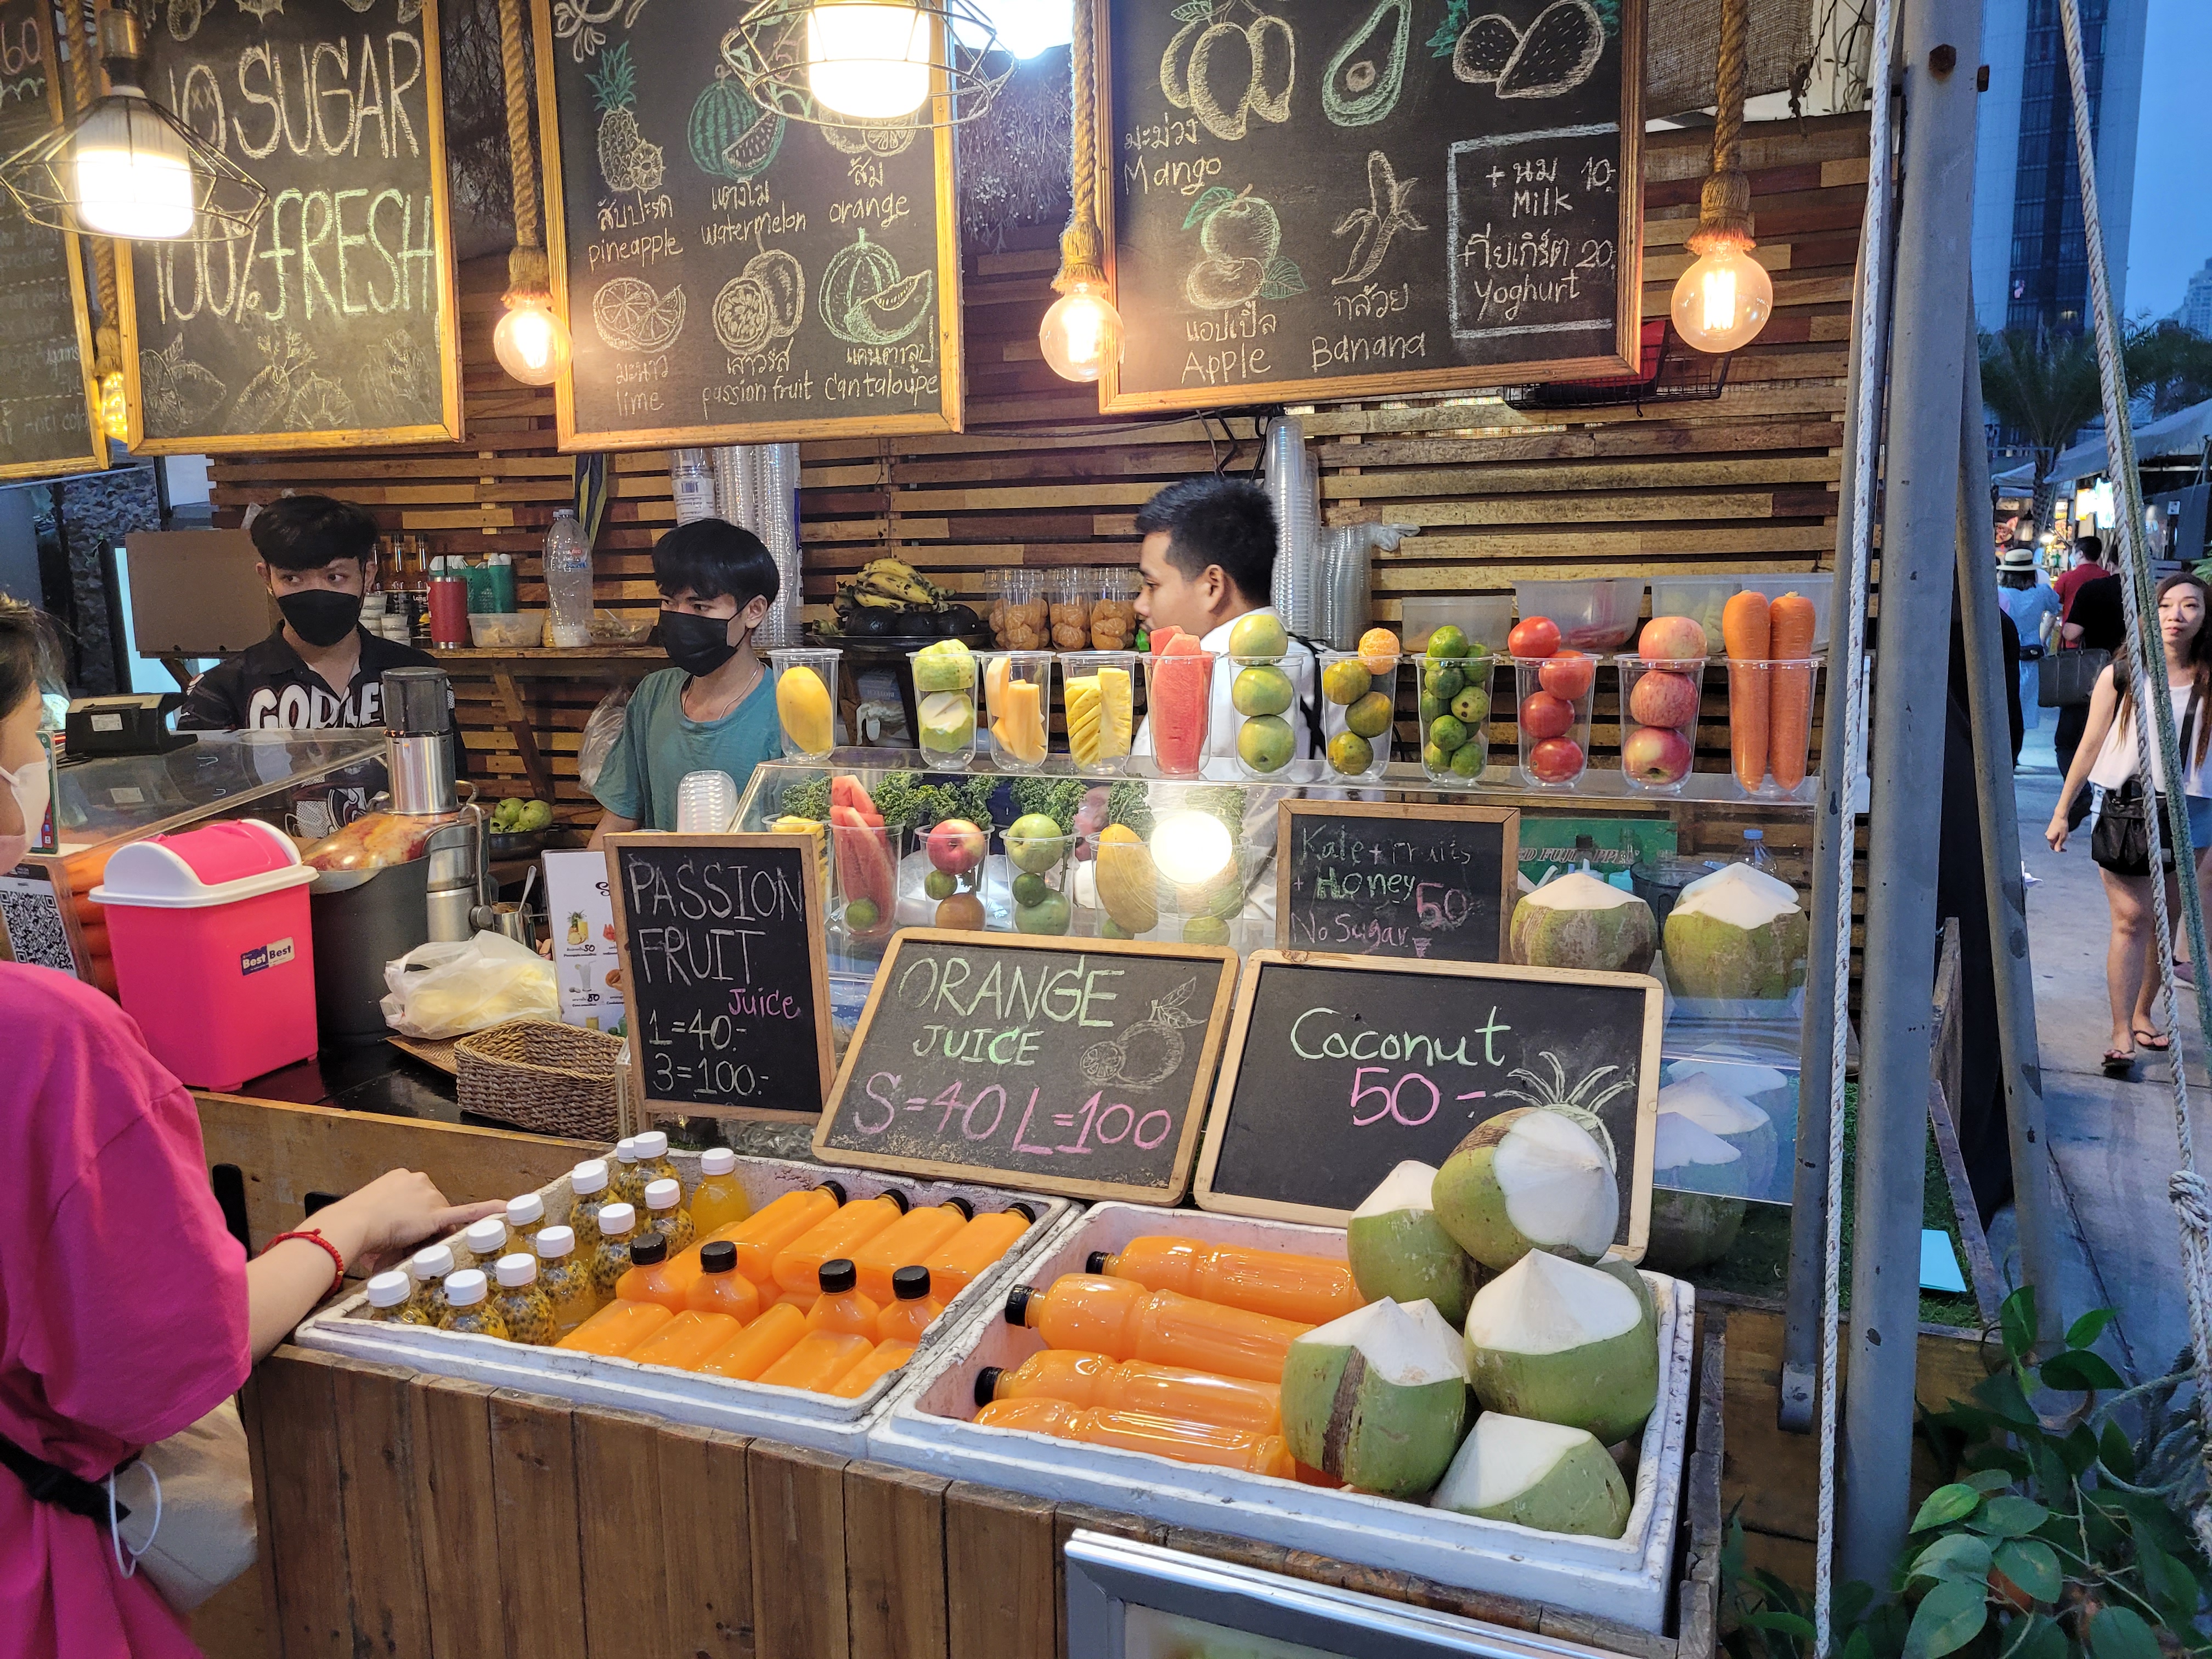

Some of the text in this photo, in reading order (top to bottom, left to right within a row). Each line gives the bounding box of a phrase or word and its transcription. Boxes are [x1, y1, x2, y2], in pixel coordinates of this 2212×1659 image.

[232, 31, 422, 159] SUGAR
[1125, 112, 1199, 151] มะม่วง
[848, 156, 883, 189] ส้ม
[1124, 155, 1222, 195] Mango
[701, 200, 806, 246] watermelon
[829, 192, 910, 230] orange
[1513, 187, 1573, 218] Milk
[589, 227, 684, 272] pineapple
[1333, 282, 1409, 321] กล้วย
[616, 354, 668, 384] มะนาว
[1181, 342, 1272, 385] Apple
[1311, 331, 1426, 373] Banana
[617, 388, 664, 416] lime
[703, 369, 814, 420] passion fruit
[1299, 824, 1365, 866] Kale
[1538, 848, 1577, 864] FUJI
[628, 854, 803, 922] PASSION
[1317, 867, 1416, 903] Honey
[1291, 910, 1410, 955] No Sugar
[242, 953, 266, 969] Best
[269, 945, 291, 960] Best
[638, 926, 766, 986] FRUIT
[727, 988, 802, 1019] Juice
[900, 955, 1125, 1027] ORANGE
[912, 1024, 1045, 1066] JUICE
[1290, 1006, 1512, 1067] Coconut
